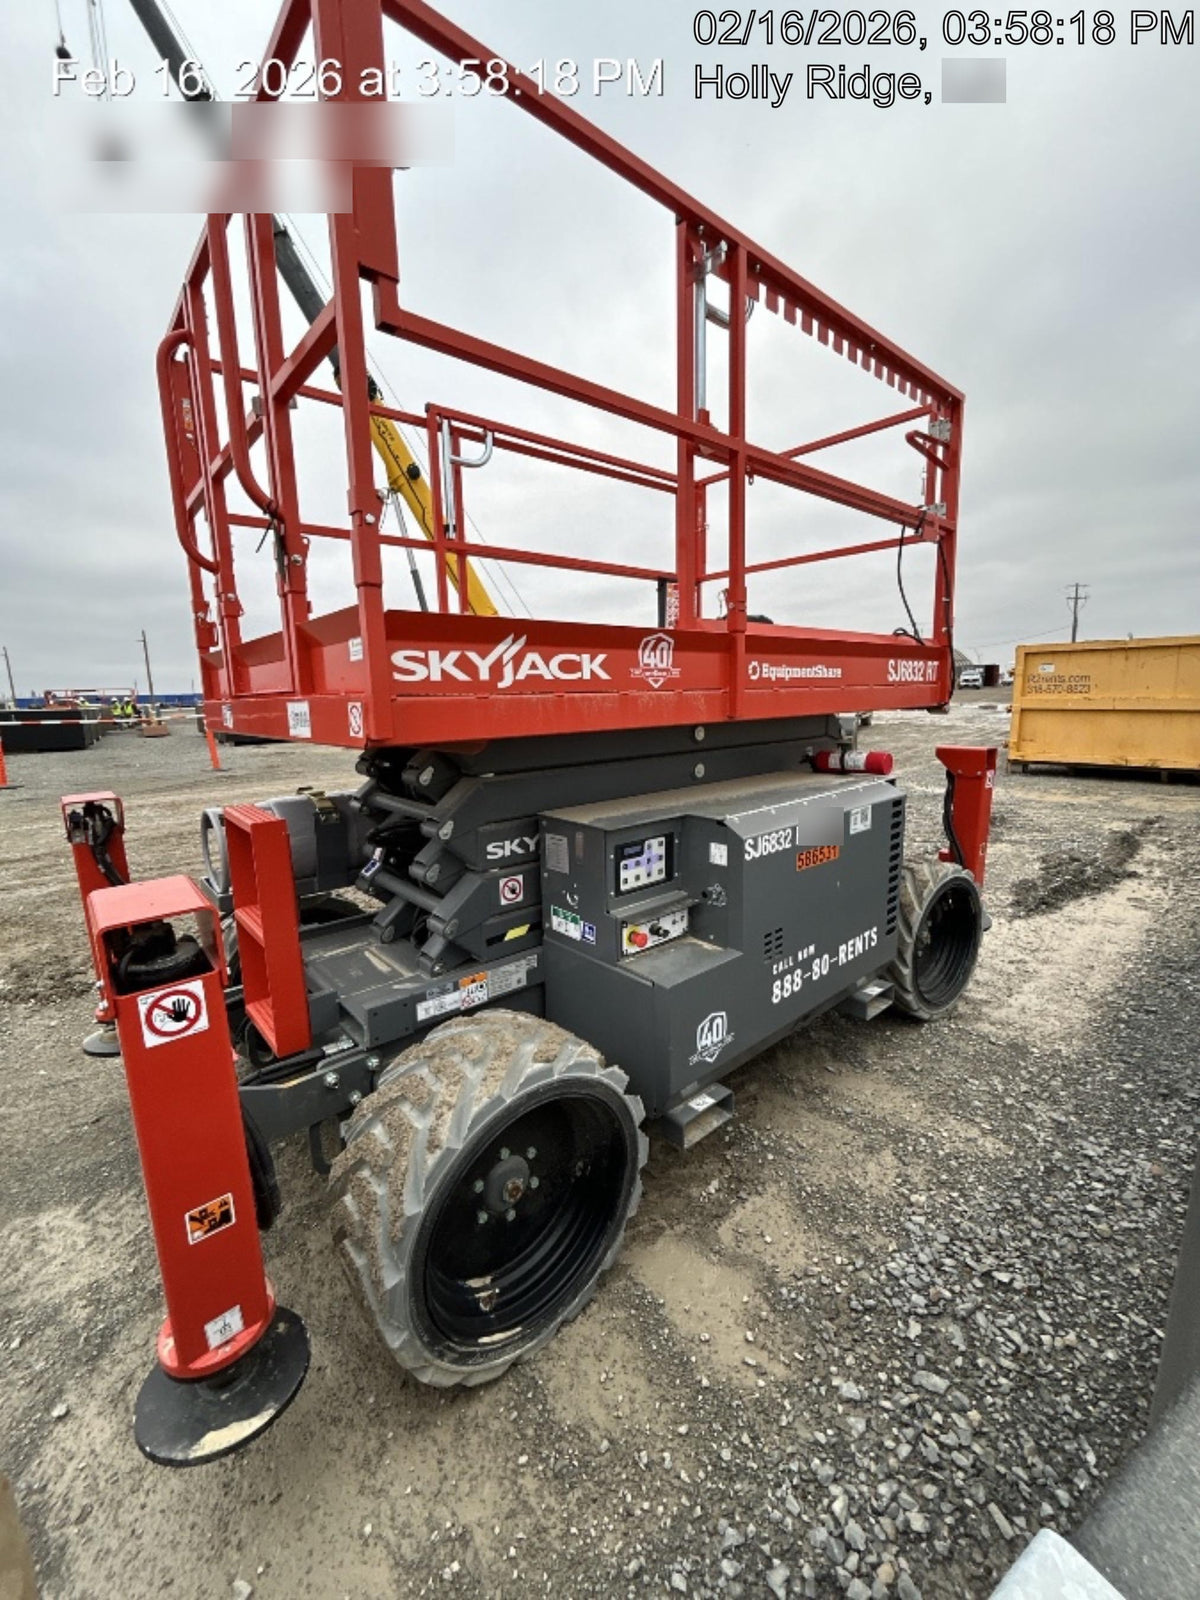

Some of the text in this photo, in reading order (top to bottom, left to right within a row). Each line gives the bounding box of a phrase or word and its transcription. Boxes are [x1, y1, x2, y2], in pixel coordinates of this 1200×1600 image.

[390, 633, 612, 688] SKYJACK
[643, 639, 669, 668] 40
[761, 663, 842, 681] EquipmentShare
[887, 659, 939, 682] SJ6832 RT
[744, 828, 792, 861] SJ6832
[772, 955, 794, 975] CALL
[772, 926, 878, 1004] 888-80-RENTS
[701, 1017, 723, 1048] 40
